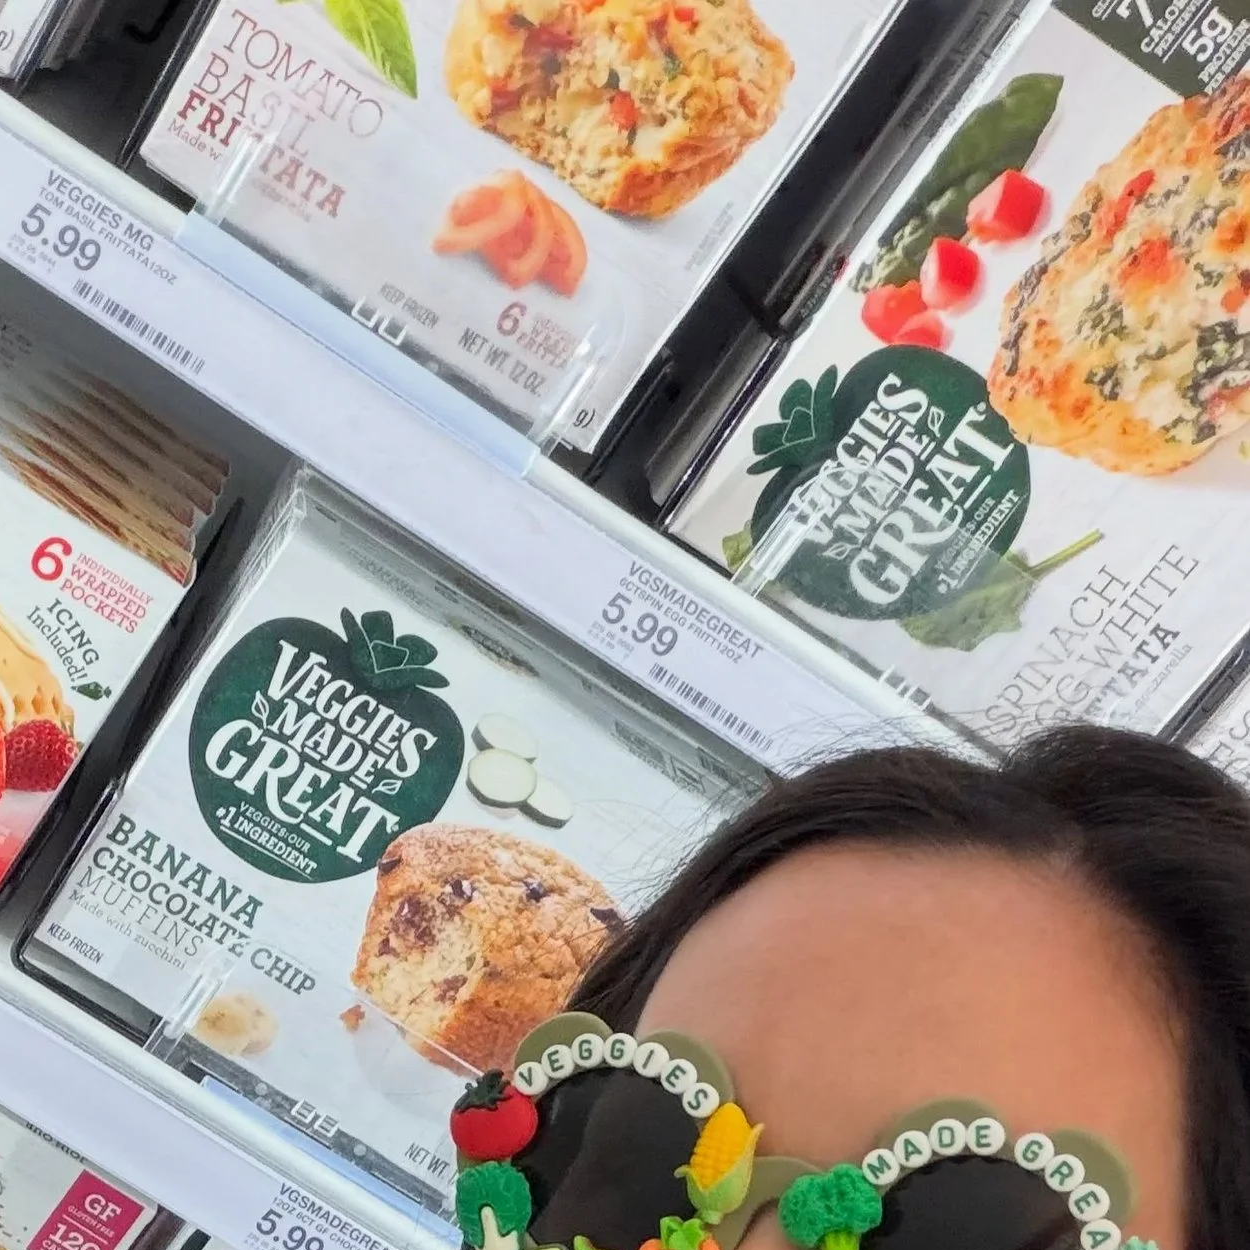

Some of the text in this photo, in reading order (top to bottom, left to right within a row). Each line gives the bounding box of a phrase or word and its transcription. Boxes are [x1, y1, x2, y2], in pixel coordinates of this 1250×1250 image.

[1180, 0, 1235, 68] 5g
[1198, 18, 1250, 83] PROTEIN
[193, 51, 319, 158] BASIL
[219, 8, 388, 137] TOMATO
[19, 202, 103, 273] 5.99
[38, 186, 65, 209] TOM
[64, 205, 96, 232] BASIL
[46, 169, 155, 252] VEGGIES MG
[456, 327, 489, 355] NET
[506, 359, 529, 383] 12
[787, 372, 930, 540] VEGGIES
[832, 423, 936, 543] MADE
[849, 406, 1015, 607] GREAT
[949, 489, 1022, 576] INGREDIENT
[29, 534, 74, 583] 6
[69, 563, 147, 620] WRAPPED
[76, 552, 154, 606] INDIVIDUALLY
[46, 597, 100, 666] ICING
[58, 577, 139, 634] POCKETS
[600, 591, 680, 658] 5.99
[627, 560, 764, 659] VGSMADEGREAT
[662, 606, 688, 627] EGG
[686, 622, 744, 664] FRITT12OZ
[1076, 543, 1200, 671] WHITE
[26, 605, 88, 683] Included!
[982, 564, 1131, 735] SPINACH
[261, 637, 440, 780] VEGGIES
[264, 697, 387, 791] MADE
[201, 716, 400, 865] GREAT
[214, 804, 318, 875] #1 INGREDIENT
[234, 801, 311, 853] VEGGIES OUR
[104, 812, 265, 930] BANANA
[46, 922, 104, 965] KEEP FROZEN
[67, 889, 187, 971] Made with zucchini
[75, 865, 204, 957] MUFFINS
[90, 845, 317, 997] CHOCOLATE CHIP
[519, 1039, 708, 1110] VEGGIES
[404, 1142, 451, 1178] NET WT.
[867, 1125, 992, 1179] MADE
[83, 1193, 122, 1223] GF
[272, 1196, 297, 1215] 12OZ
[295, 1211, 316, 1227] 6CT
[315, 1223, 329, 1235] GF
